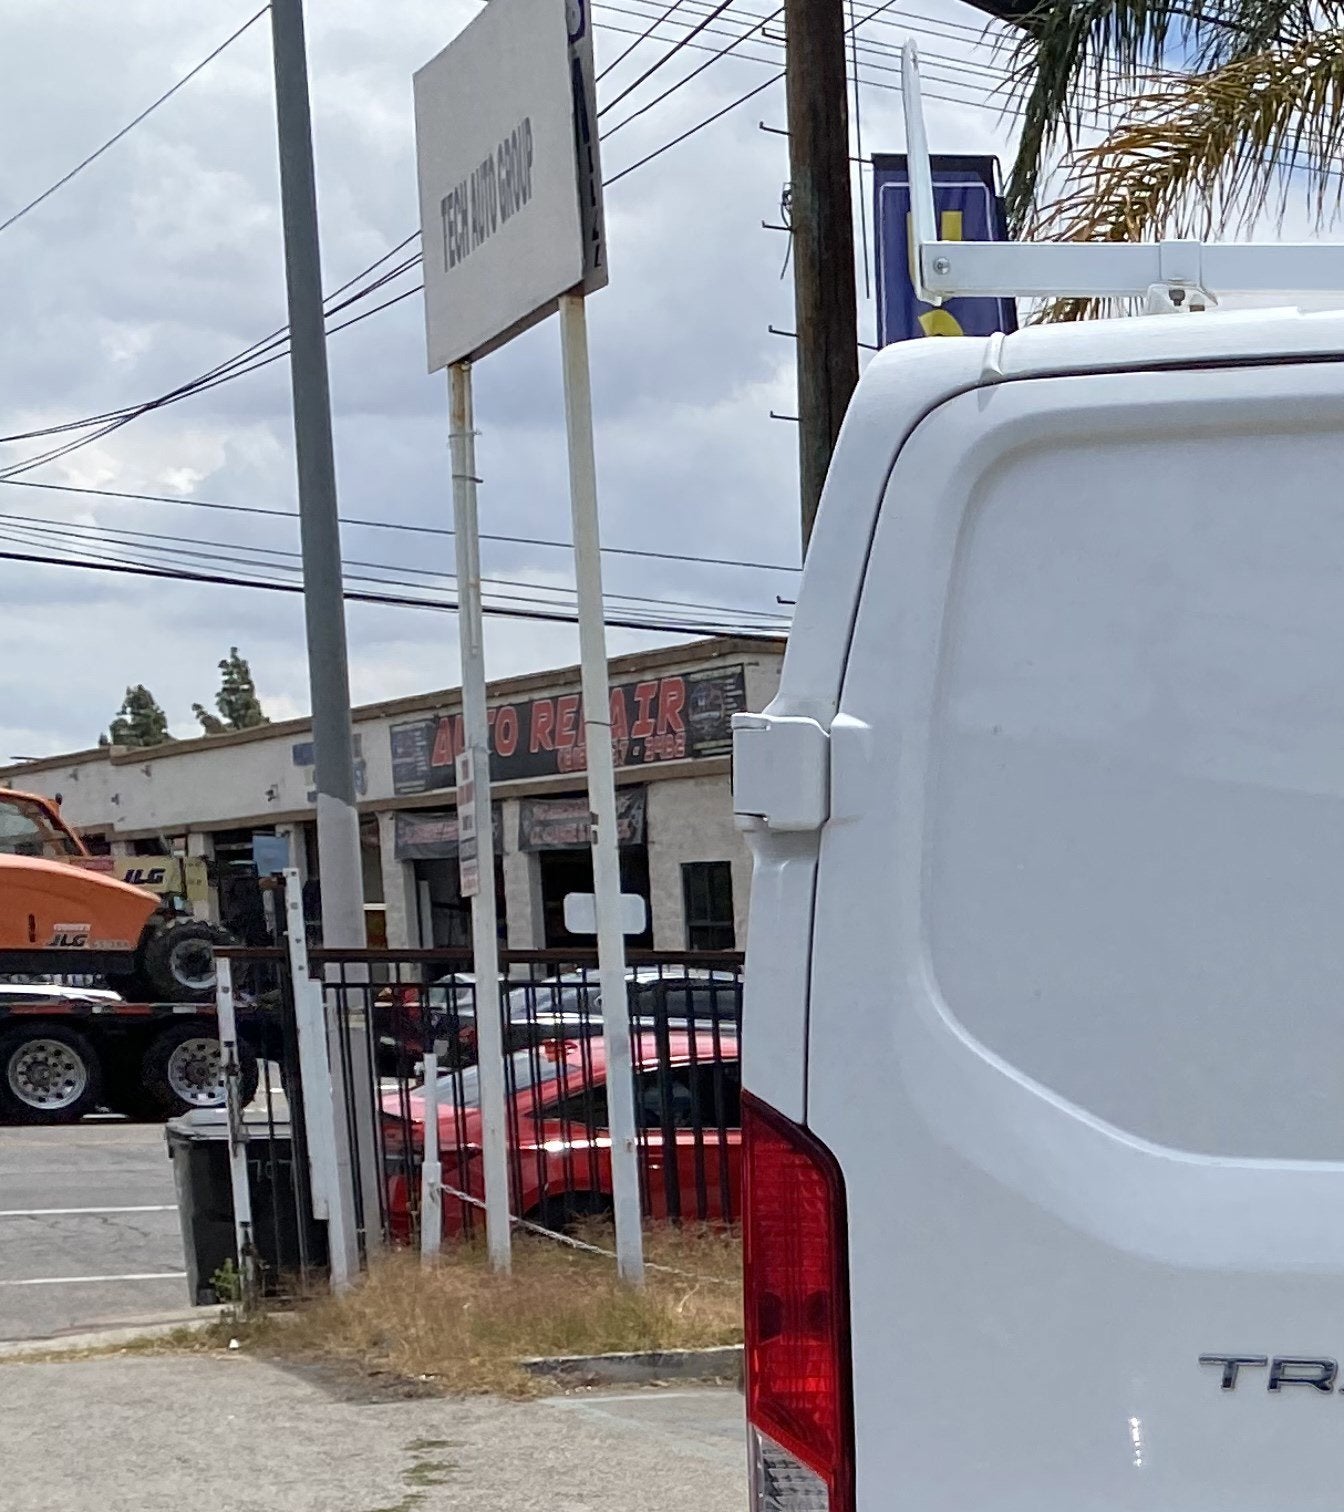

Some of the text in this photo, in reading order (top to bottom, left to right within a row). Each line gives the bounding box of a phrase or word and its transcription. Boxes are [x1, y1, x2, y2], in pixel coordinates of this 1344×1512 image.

[441, 117, 533, 273] TECH AUTO GROUP
[431, 706, 518, 766] AO
[123, 868, 166, 884] JLG
[48, 933, 89, 947] JLG
